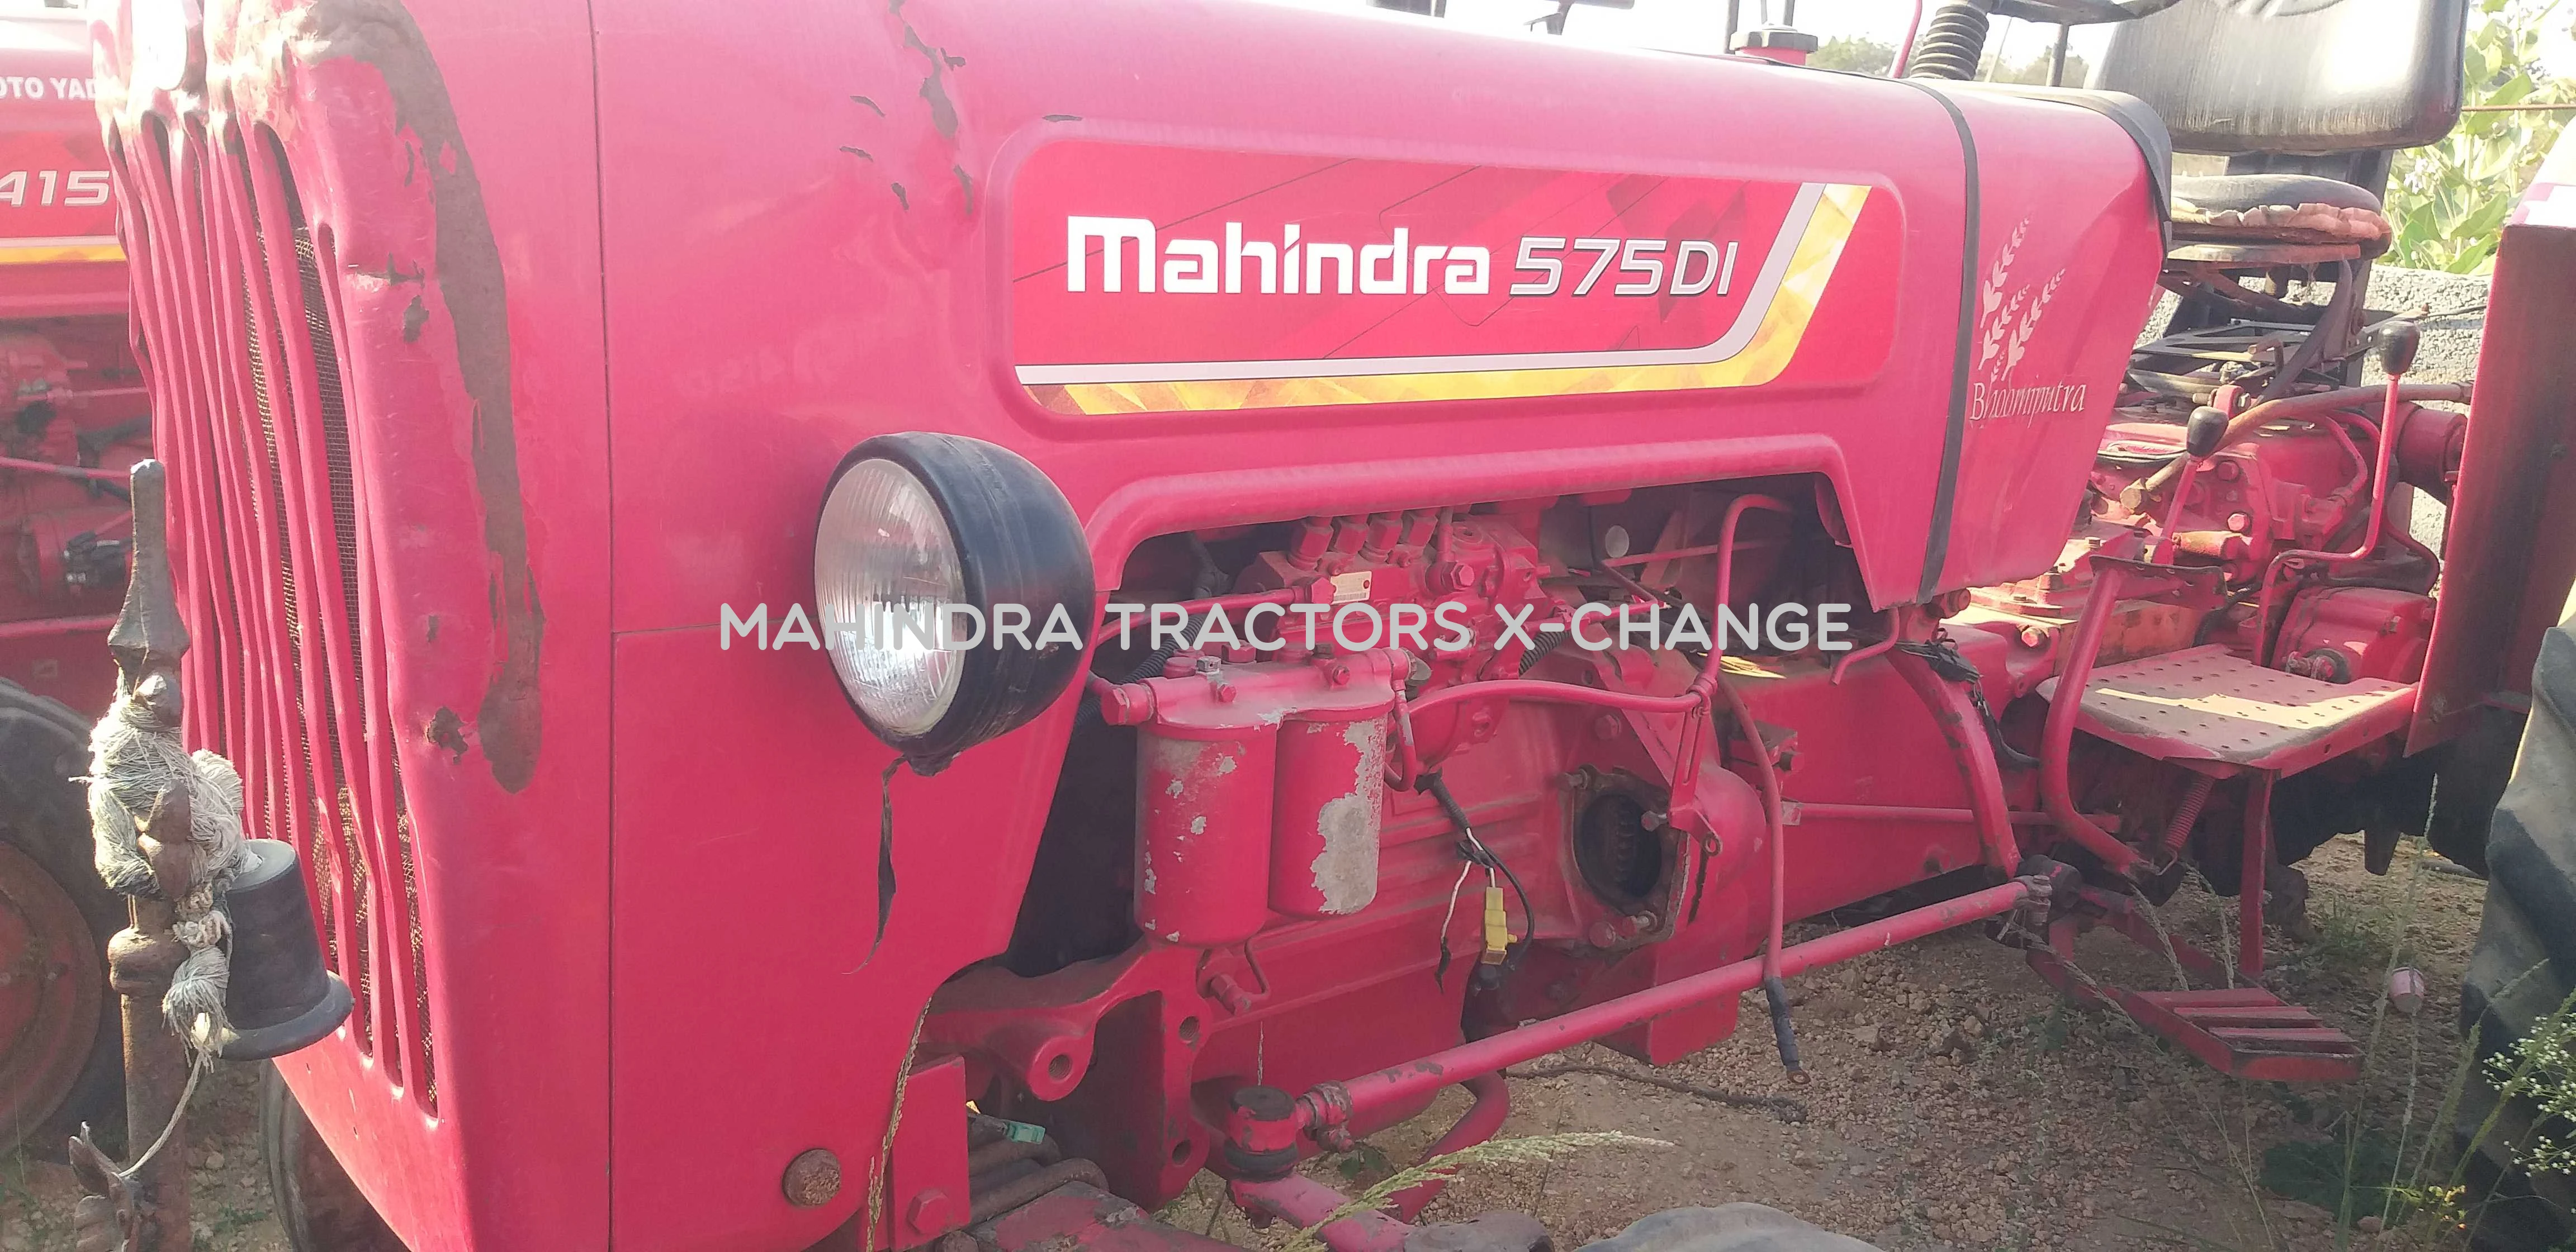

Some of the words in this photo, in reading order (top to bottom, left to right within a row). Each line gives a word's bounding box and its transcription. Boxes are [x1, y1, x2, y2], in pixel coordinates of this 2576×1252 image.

[0, 170, 111, 206] 415
[1067, 215, 1491, 295] Mahindra
[1509, 236, 1739, 296] 575DI
[1969, 377, 2087, 429] Bhoomiputra
